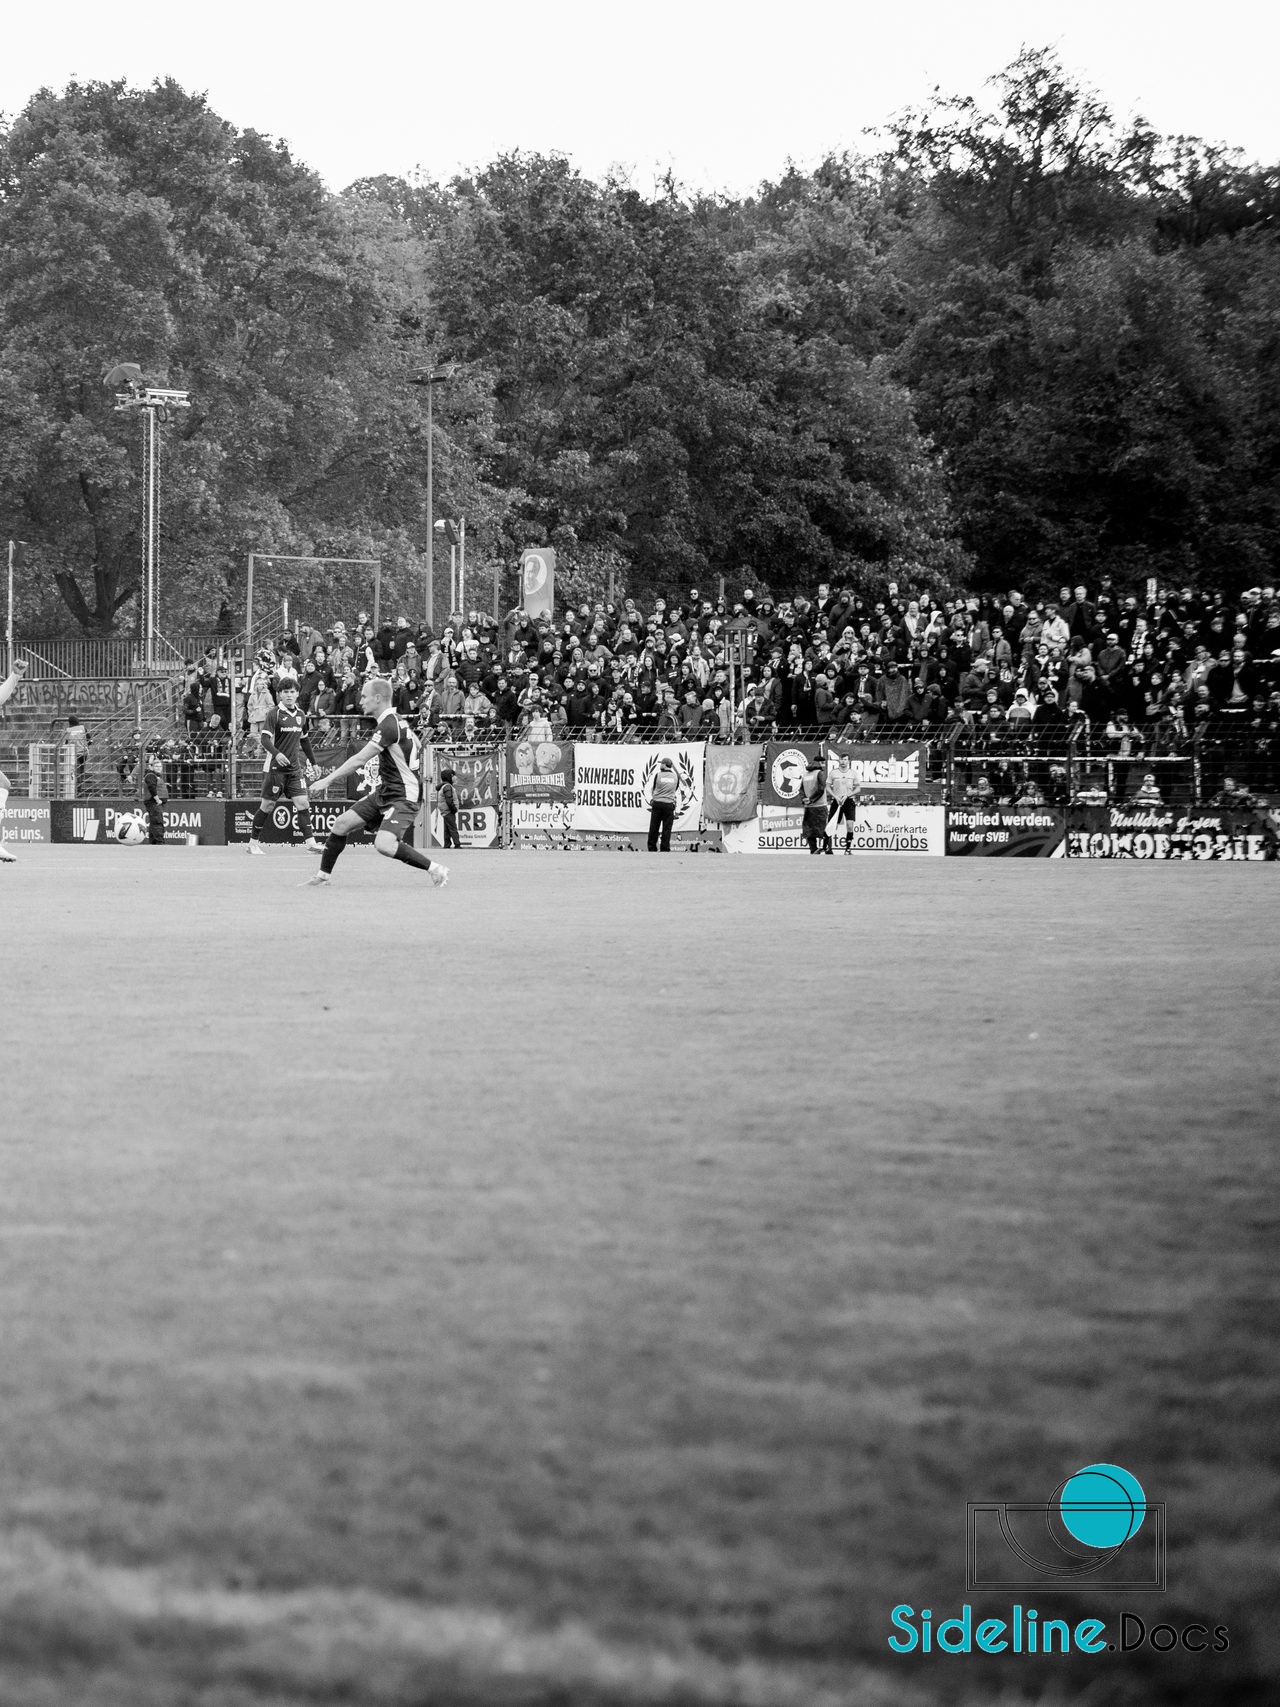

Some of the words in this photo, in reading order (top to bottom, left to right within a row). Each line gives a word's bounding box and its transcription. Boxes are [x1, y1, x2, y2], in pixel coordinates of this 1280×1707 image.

[577, 766, 633, 786] SKINHEADS
[577, 790, 640, 808] BABELSBERG
[521, 809, 558, 822] Unsere
[562, 809, 575, 821] Kr
[948, 811, 998, 829] Mitglied
[1001, 813, 1054, 827] werden.
[762, 817, 793, 830] Bewirb
[876, 823, 928, 834] Dauerkarte
[20, 828, 44, 840] uns.
[950, 831, 966, 842] Nur
[968, 831, 984, 842] der
[985, 831, 1009, 842] SVB!
